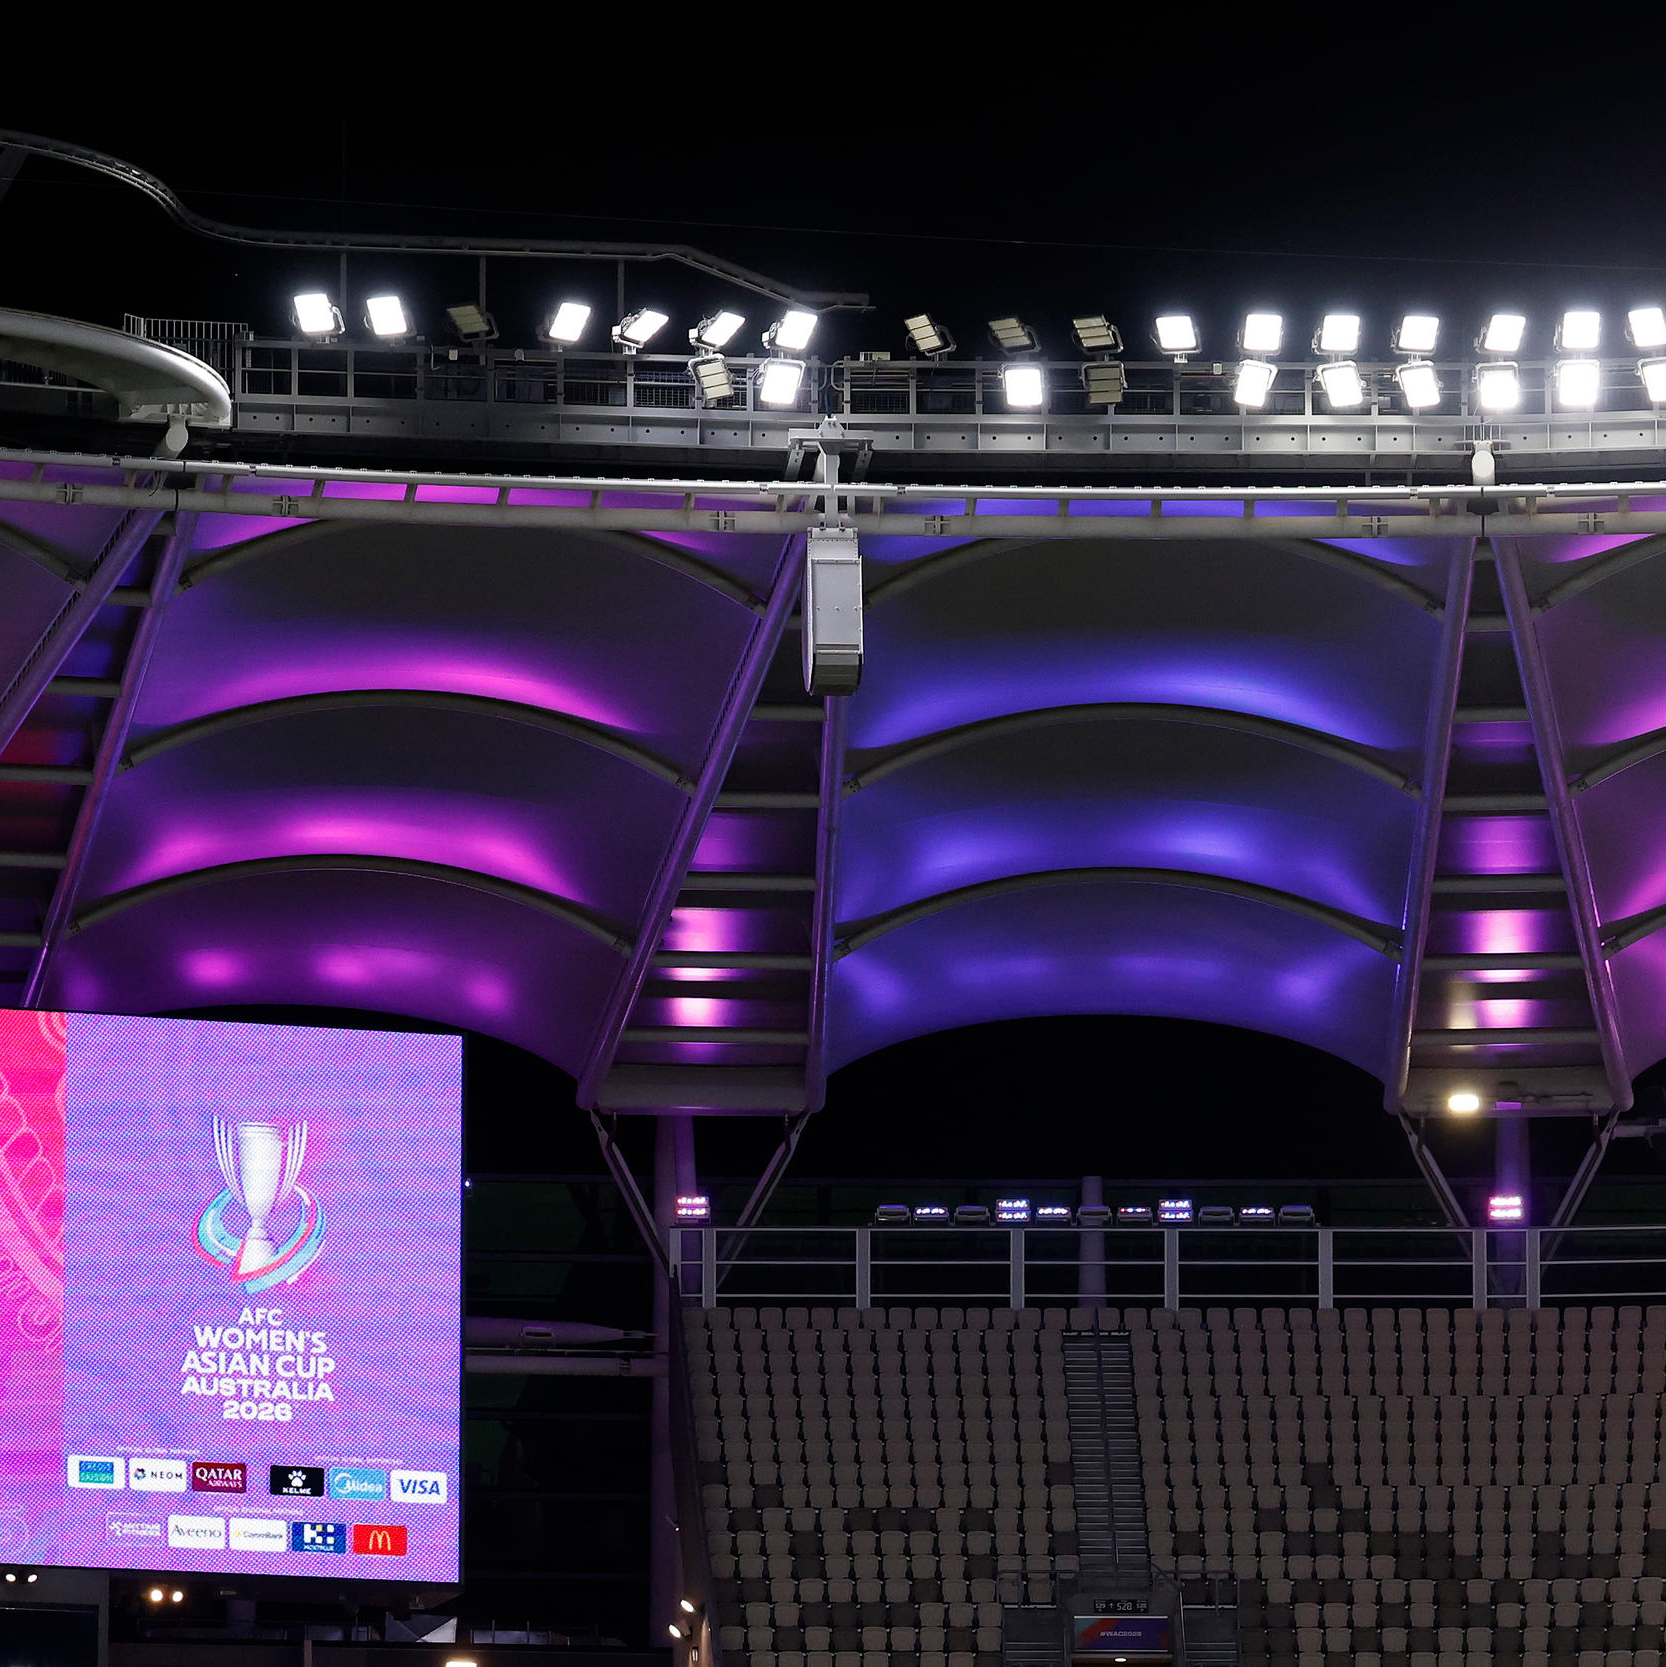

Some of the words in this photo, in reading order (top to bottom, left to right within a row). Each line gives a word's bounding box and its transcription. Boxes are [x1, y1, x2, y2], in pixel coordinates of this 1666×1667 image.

[238, 1307, 283, 1326] AFC
[193, 1325, 327, 1353] WOMEN'S
[182, 1351, 270, 1376] ASIAN
[275, 1355, 335, 1379] CUP
[181, 1376, 335, 1401] AUSTRALIA
[223, 1400, 293, 1421] 2026
[151, 1470, 183, 1480] NEOM
[195, 1467, 242, 1482] QATAR
[399, 1479, 440, 1495] VISA
[173, 1524, 221, 1538] Aveeno
[1117, 1602, 1132, 1611] 528
